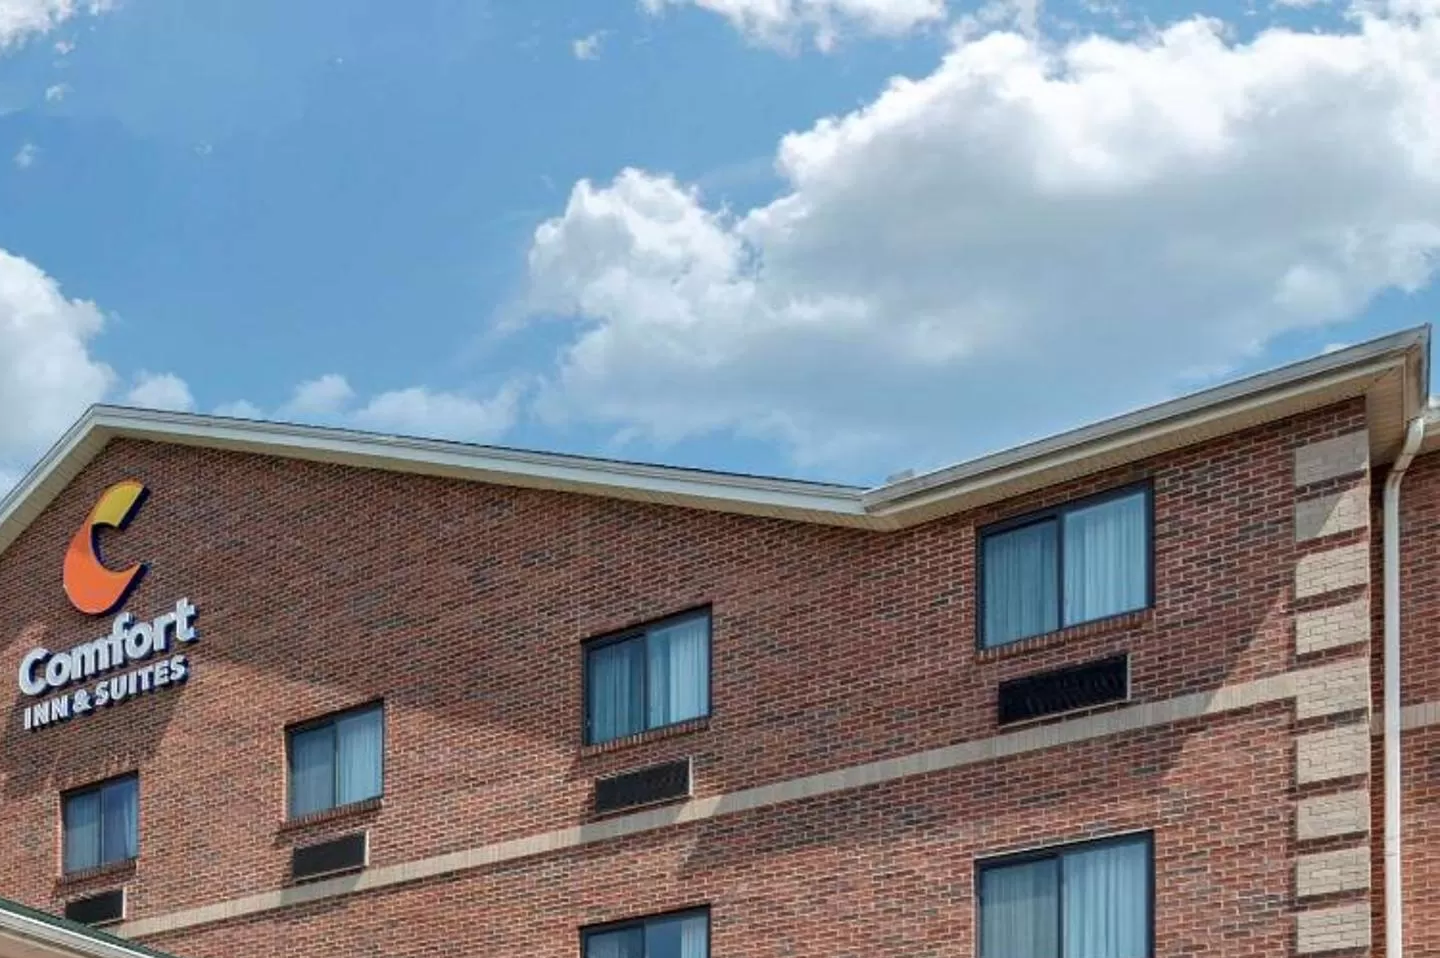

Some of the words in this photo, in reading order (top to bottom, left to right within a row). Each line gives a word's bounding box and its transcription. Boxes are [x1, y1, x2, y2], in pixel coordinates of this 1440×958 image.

[18, 598, 196, 696] Comfort
[24, 695, 69, 730] INN
[72, 688, 92, 713] &
[95, 654, 187, 705] SUITES
